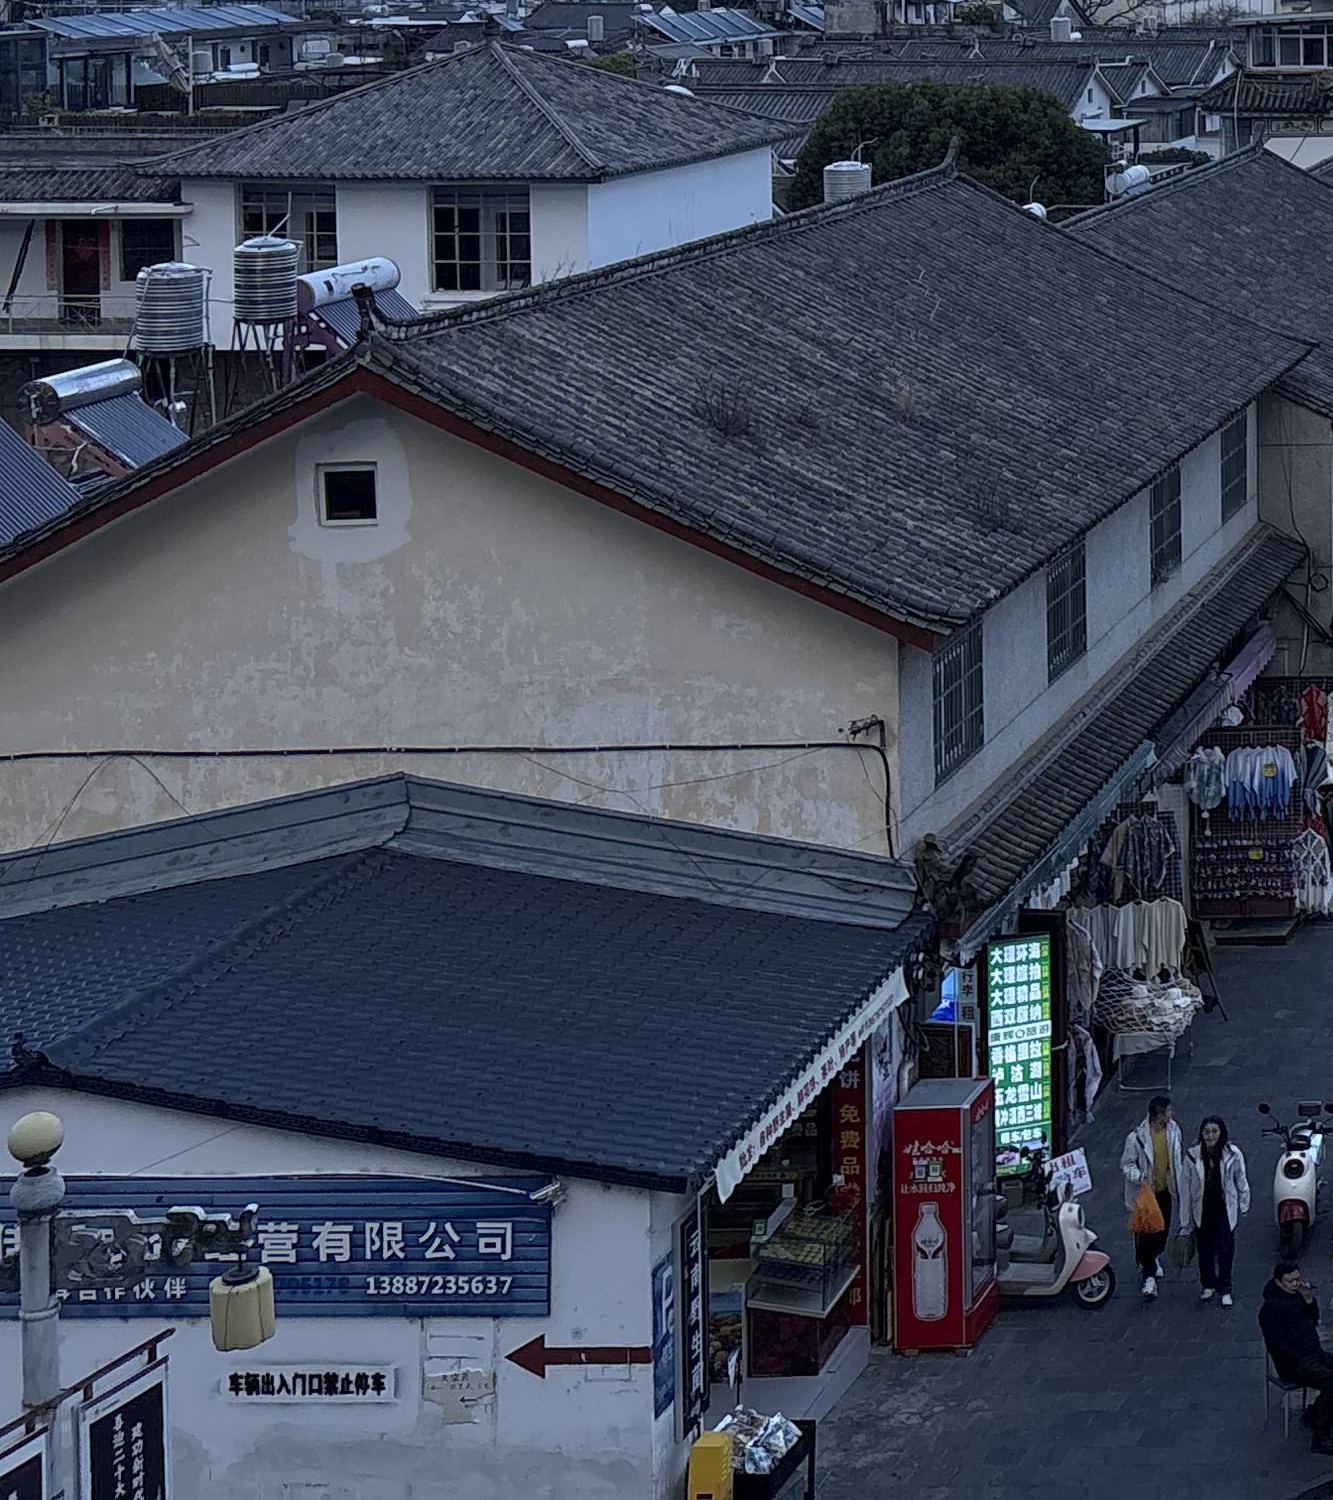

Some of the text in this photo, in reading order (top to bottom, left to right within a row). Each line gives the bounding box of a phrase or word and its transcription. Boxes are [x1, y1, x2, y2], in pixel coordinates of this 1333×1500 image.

[366, 1275, 513, 1296] 13887235637
[229, 1371, 386, 1397] 车辆出入门口禁止停车
